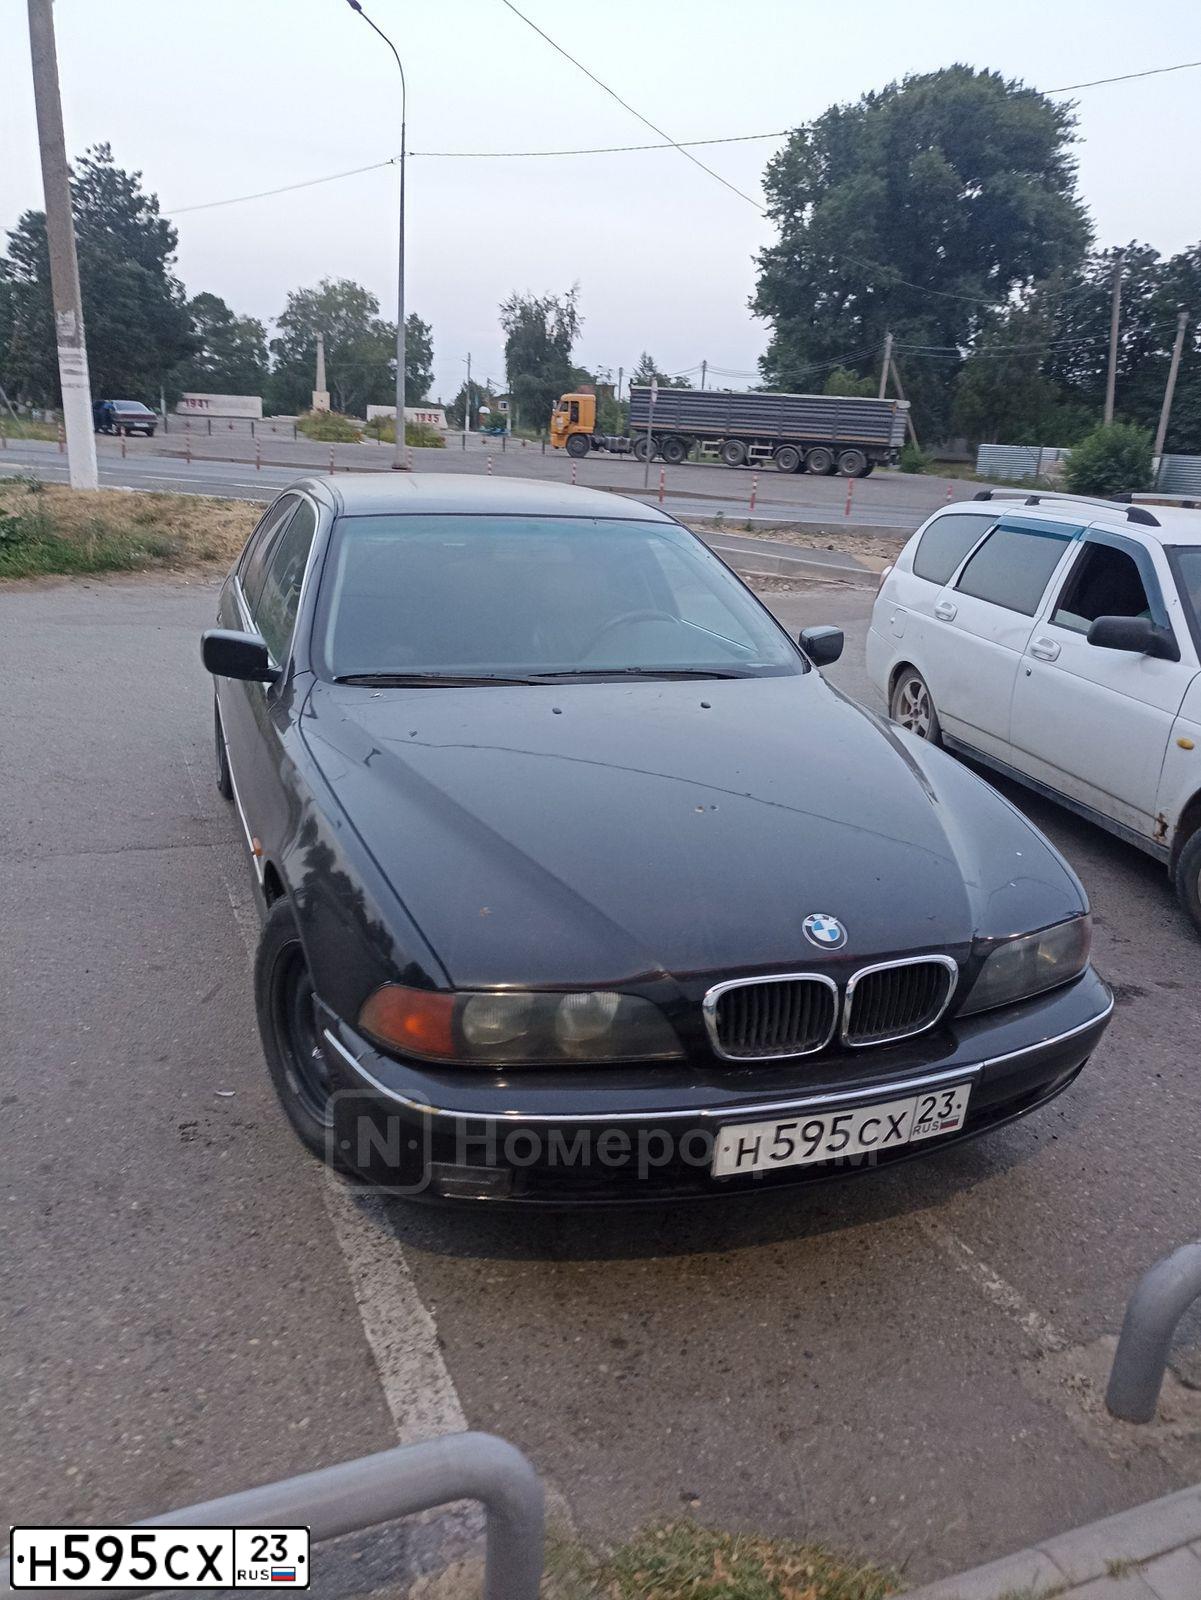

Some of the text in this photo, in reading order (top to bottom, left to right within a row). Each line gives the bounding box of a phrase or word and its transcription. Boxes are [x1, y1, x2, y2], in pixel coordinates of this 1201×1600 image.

[735, 1090, 957, 1168] Н595СХ 23
[912, 1119, 940, 1137] RUS
